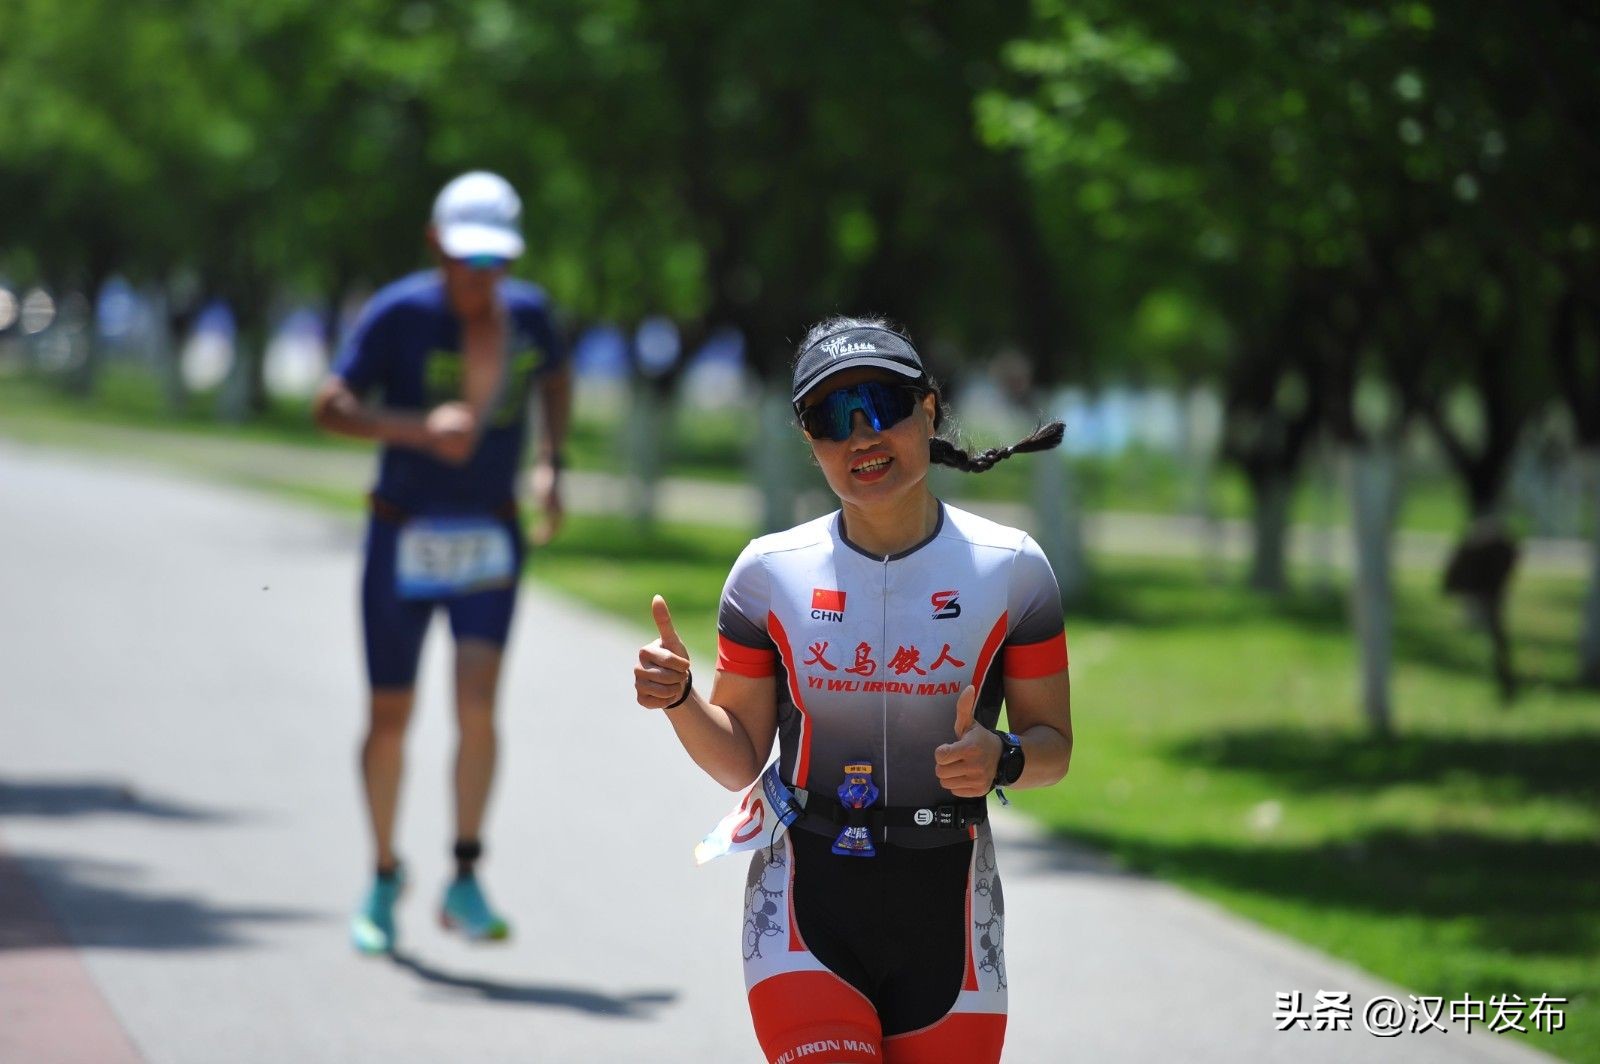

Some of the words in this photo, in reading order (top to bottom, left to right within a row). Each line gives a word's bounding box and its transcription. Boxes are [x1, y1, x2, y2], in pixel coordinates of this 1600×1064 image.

[811, 609, 843, 622] CHN
[803, 641, 966, 677] 义乌铁人
[808, 676, 824, 690] YI
[827, 679, 860, 692] WU
[863, 681, 913, 695] IRON
[916, 681, 961, 696] MAN
[796, 1040, 840, 1057] IRON
[843, 1039, 876, 1056] MAN
